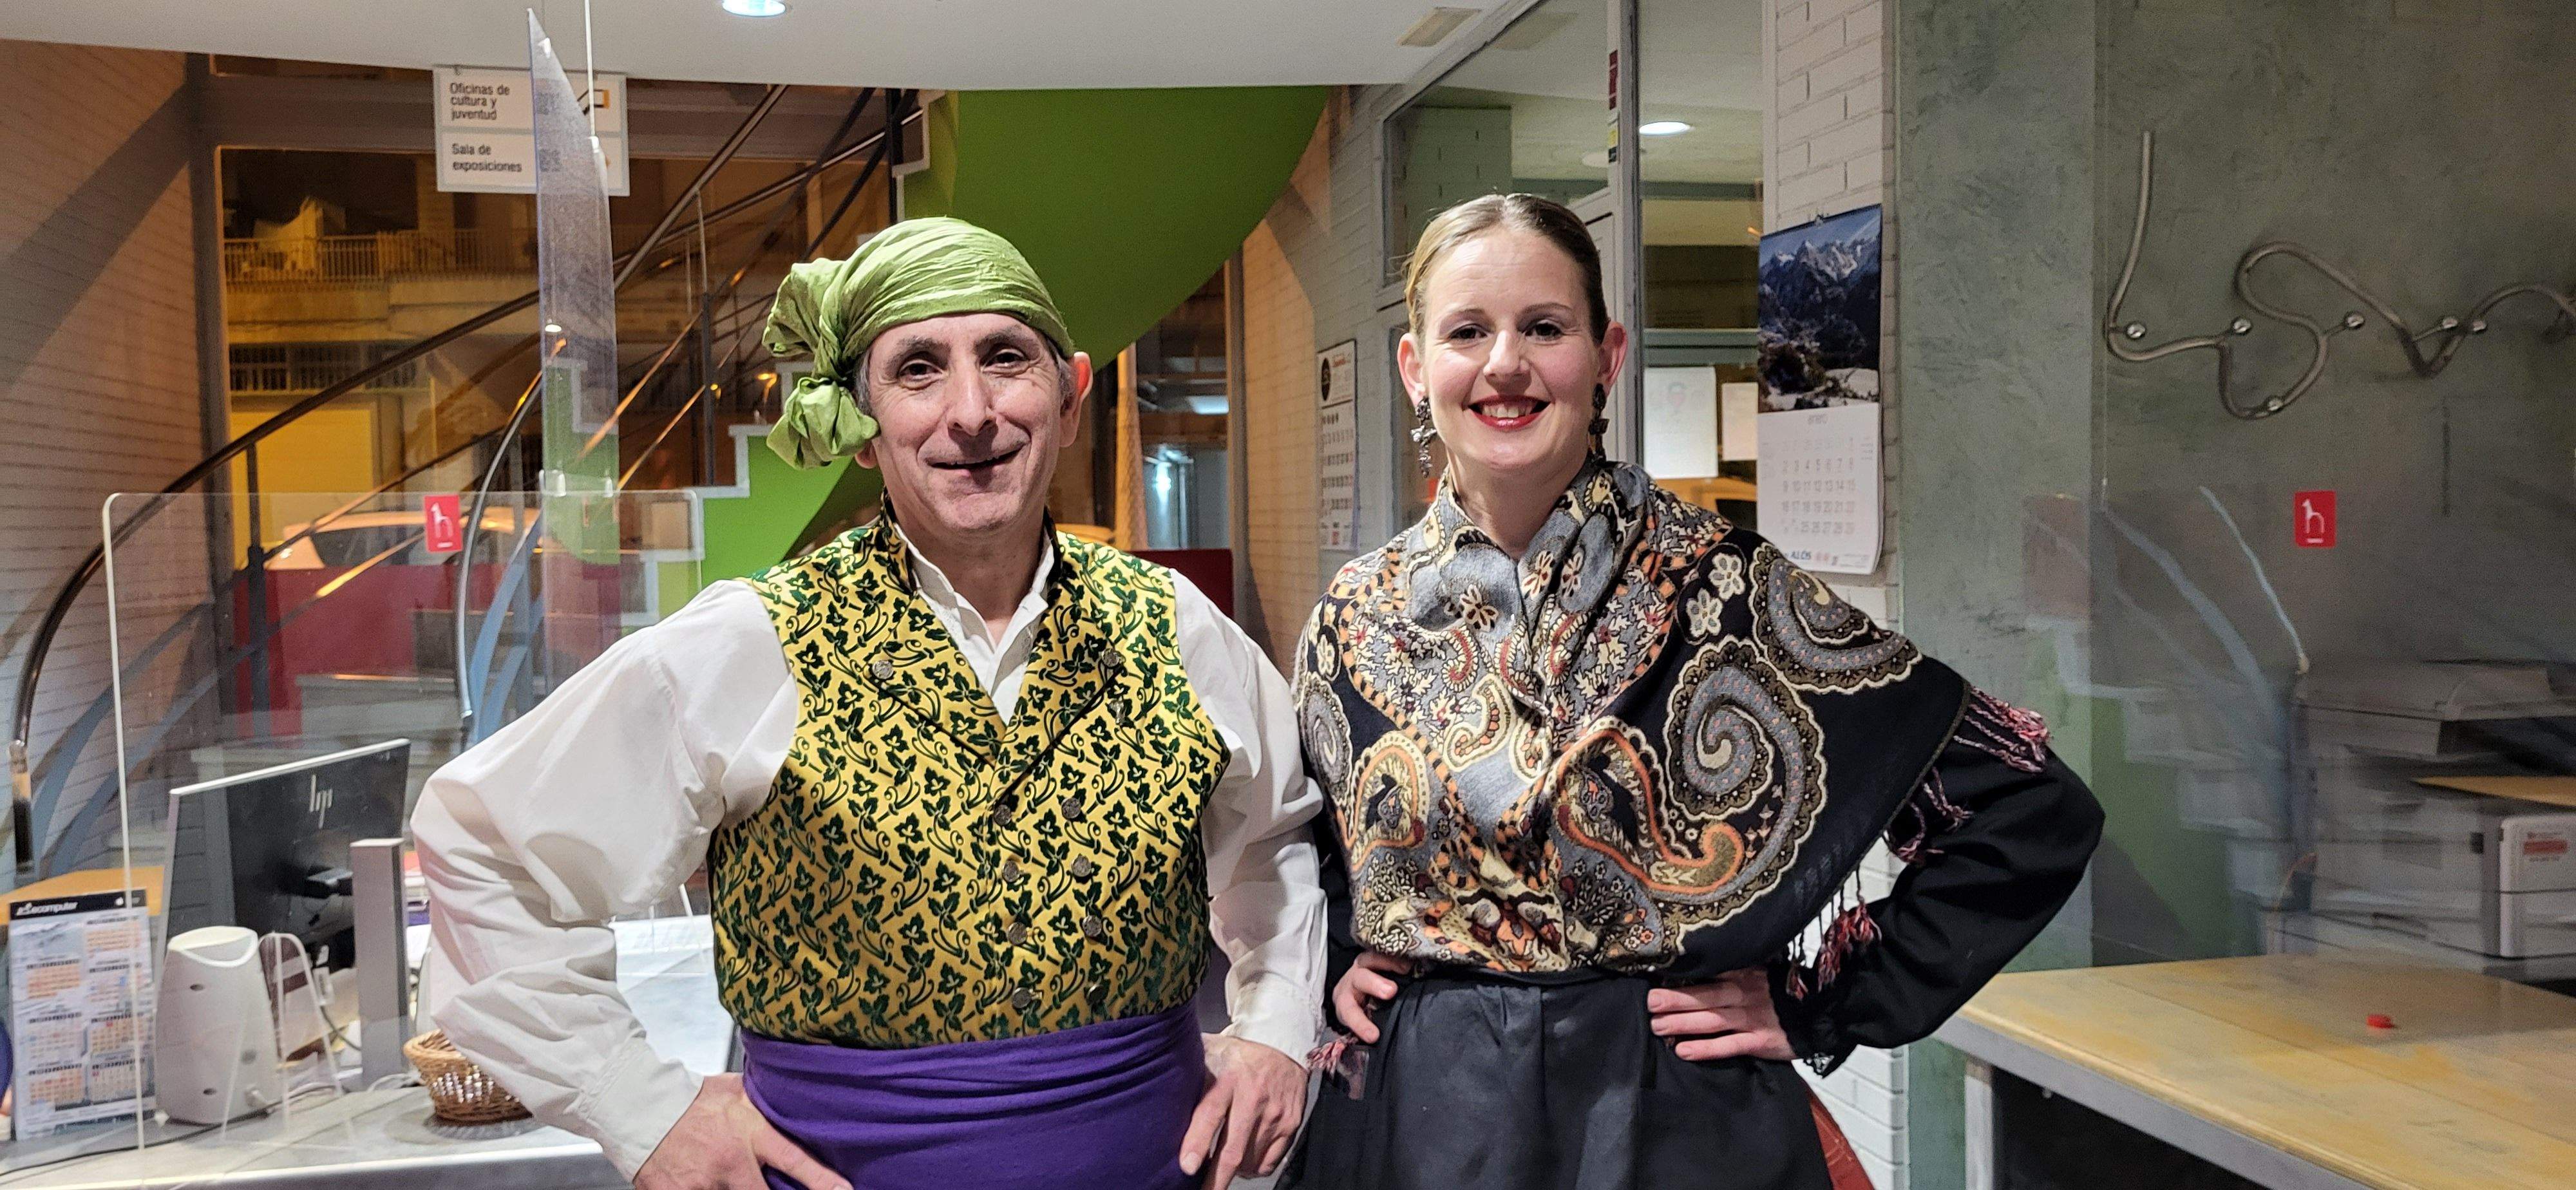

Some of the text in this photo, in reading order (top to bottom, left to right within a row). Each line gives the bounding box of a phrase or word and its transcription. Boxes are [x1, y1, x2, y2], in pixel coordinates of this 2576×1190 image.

[451, 82, 510, 95] Oficinas de
[451, 97, 497, 109] cultura y
[451, 109, 497, 121] juventud
[452, 143, 491, 155] Sala de
[453, 160, 522, 173] exposiciones
[309, 774, 333, 829] hp
